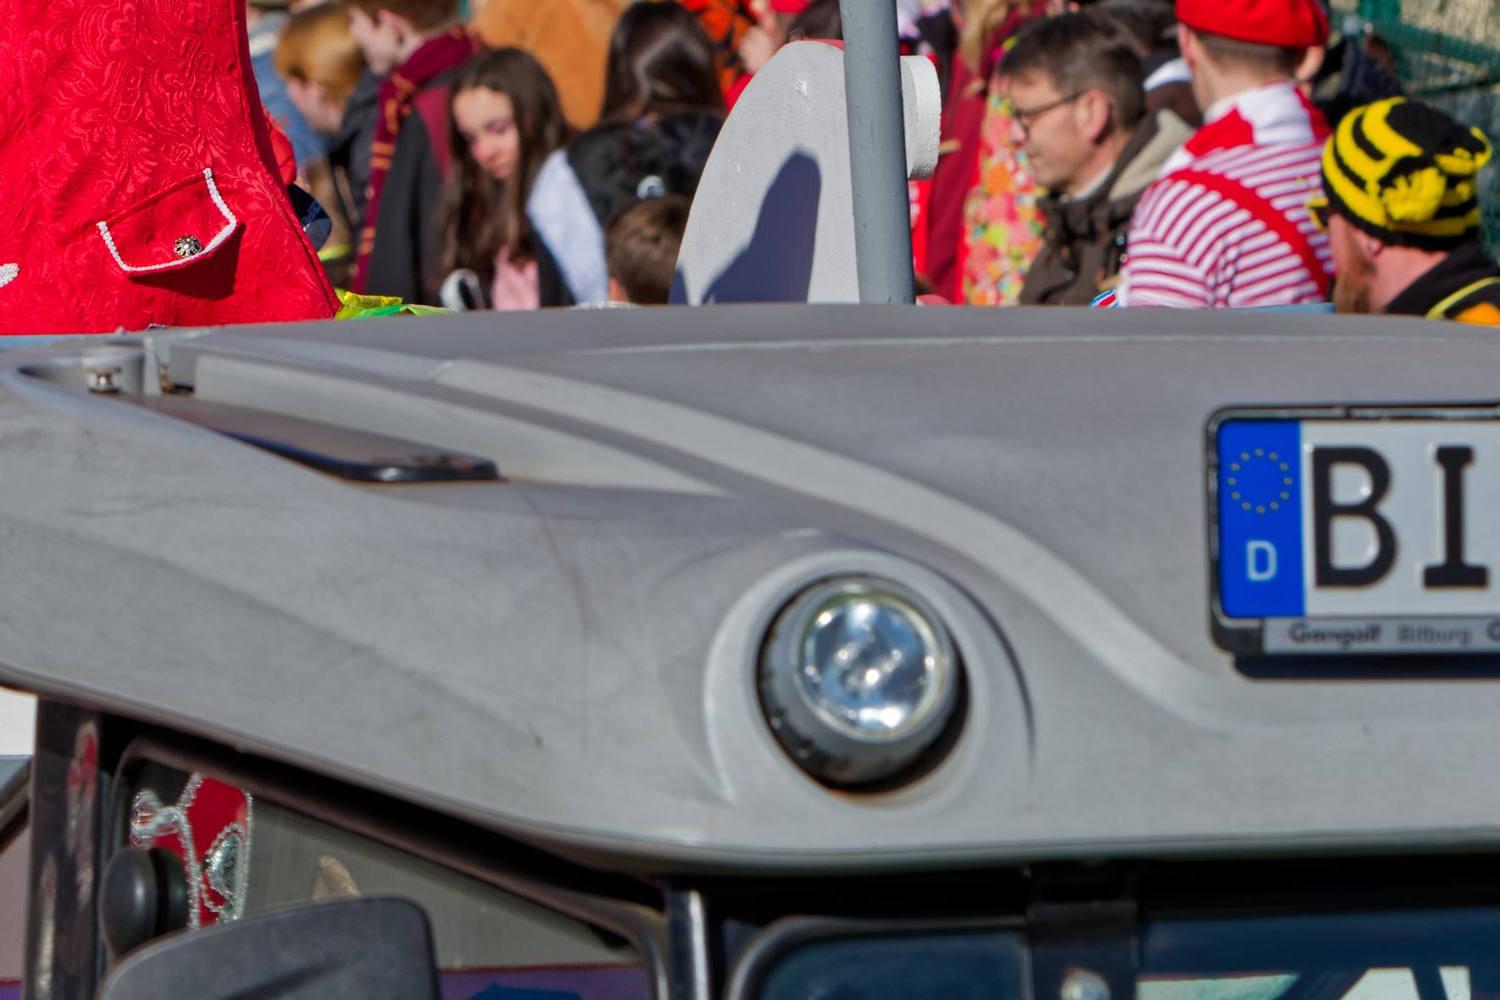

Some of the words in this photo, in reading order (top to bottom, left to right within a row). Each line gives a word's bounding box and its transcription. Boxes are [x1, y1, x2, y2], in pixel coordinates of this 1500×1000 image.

[1312, 446, 1490, 589] BI
[1246, 540, 1278, 582] D
[1397, 623, 1473, 648] Bitburg
